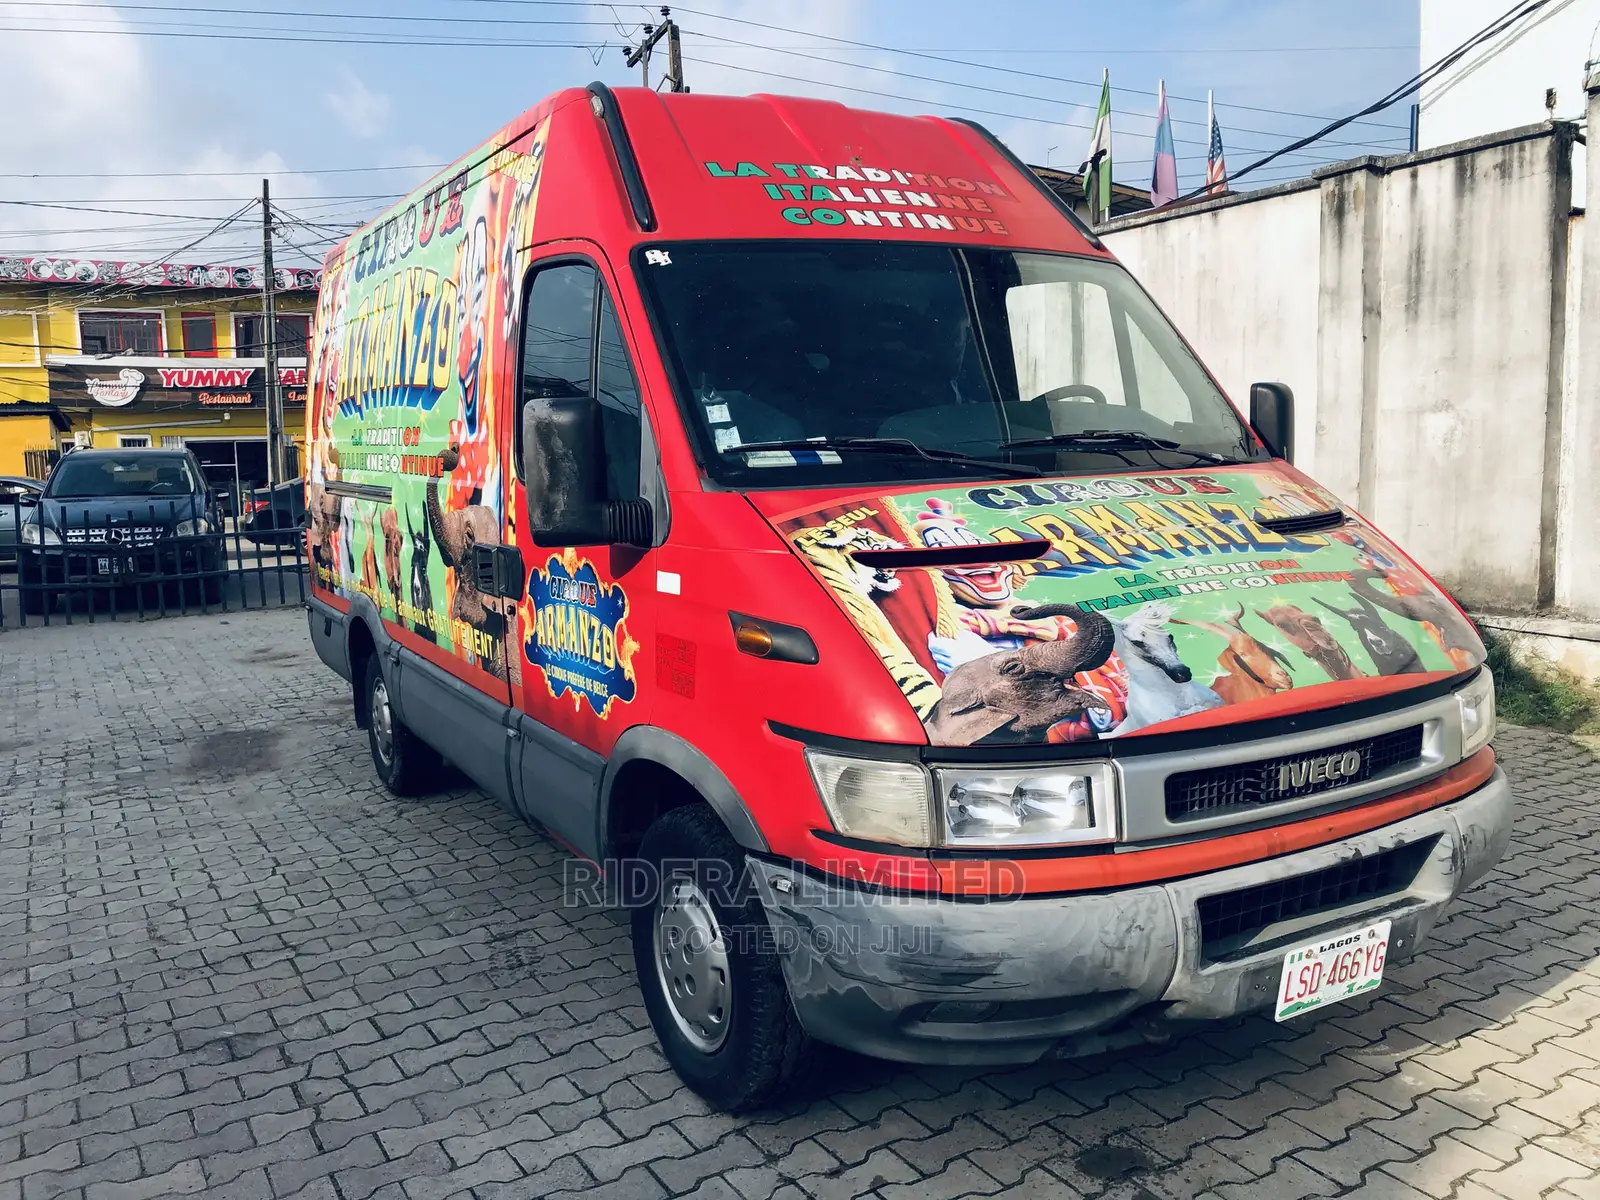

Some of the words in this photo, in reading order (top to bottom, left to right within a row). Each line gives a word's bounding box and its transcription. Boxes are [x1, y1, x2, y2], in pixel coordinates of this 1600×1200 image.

[703, 160, 770, 178] LA
[771, 162, 1009, 198] TRADITION
[763, 183, 994, 214] ITALIENNE
[354, 165, 470, 283] CIRQUE
[782, 207, 1010, 236] CONTINUE
[157, 368, 255, 388] YUMMY
[199, 392, 252, 405] Restaurant
[967, 476, 1236, 510] CIRQUE
[796, 527, 831, 548] LE
[825, 506, 880, 532] SEUL
[1114, 573, 1158, 588] LA
[1159, 558, 1303, 581] TRADITION
[550, 575, 597, 607] CIRQUE
[1076, 579, 1228, 613] ITALIENNE
[1231, 570, 1356, 590] CONTINUE
[426, 608, 493, 661] GRATUITEMENT
[536, 605, 616, 669] ARMANZO
[1279, 751, 1360, 791] IVECO
[1319, 934, 1361, 953] LAGOS
